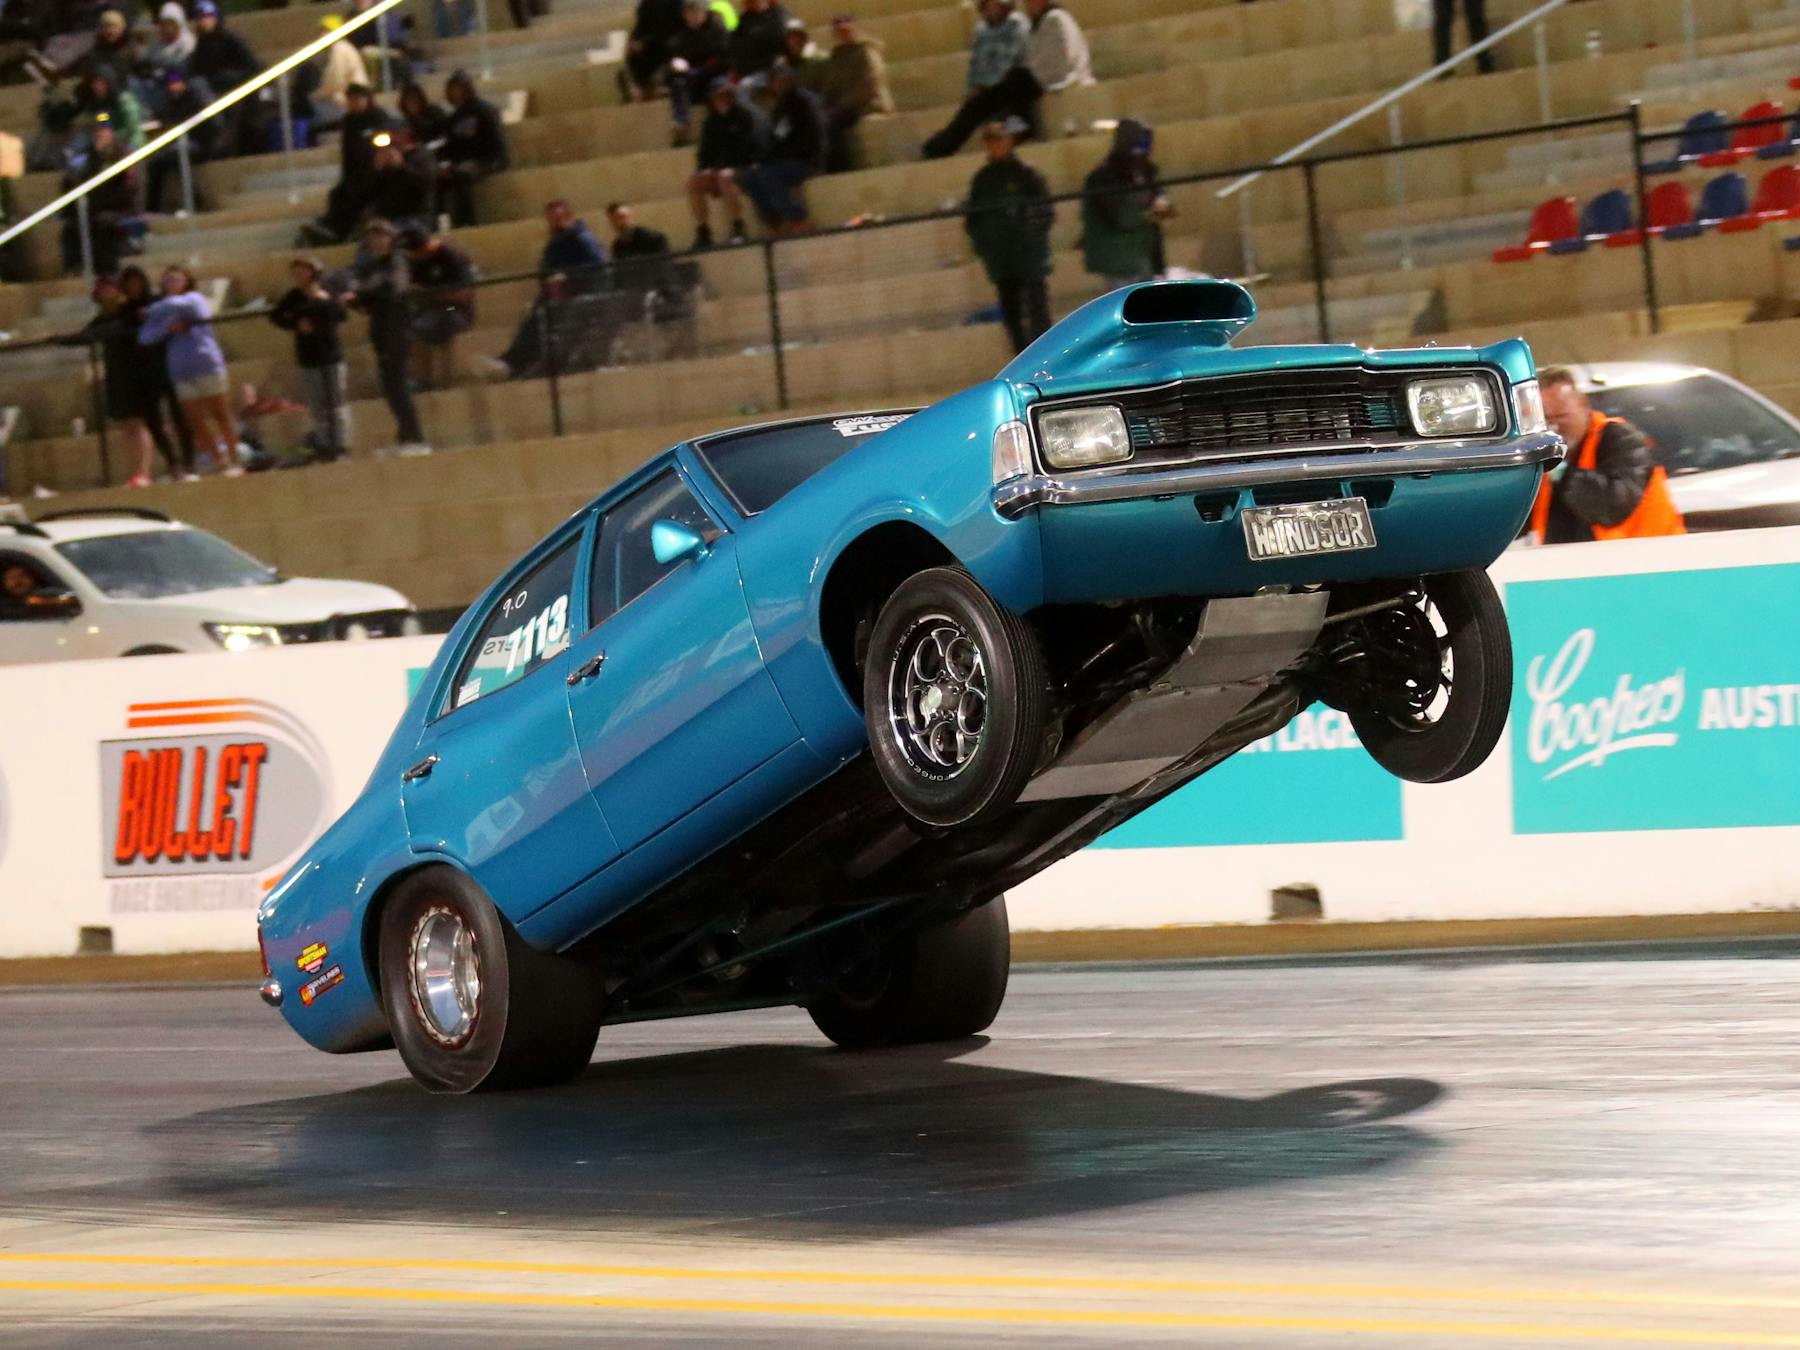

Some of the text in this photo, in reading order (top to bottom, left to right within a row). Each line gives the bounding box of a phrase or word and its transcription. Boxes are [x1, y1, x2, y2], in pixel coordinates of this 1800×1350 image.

[1251, 512, 1368, 556] WINDSOR
[1698, 684, 1800, 730] AUST
[1277, 709, 1364, 752] LAGE
[115, 742, 268, 865] BULLET
